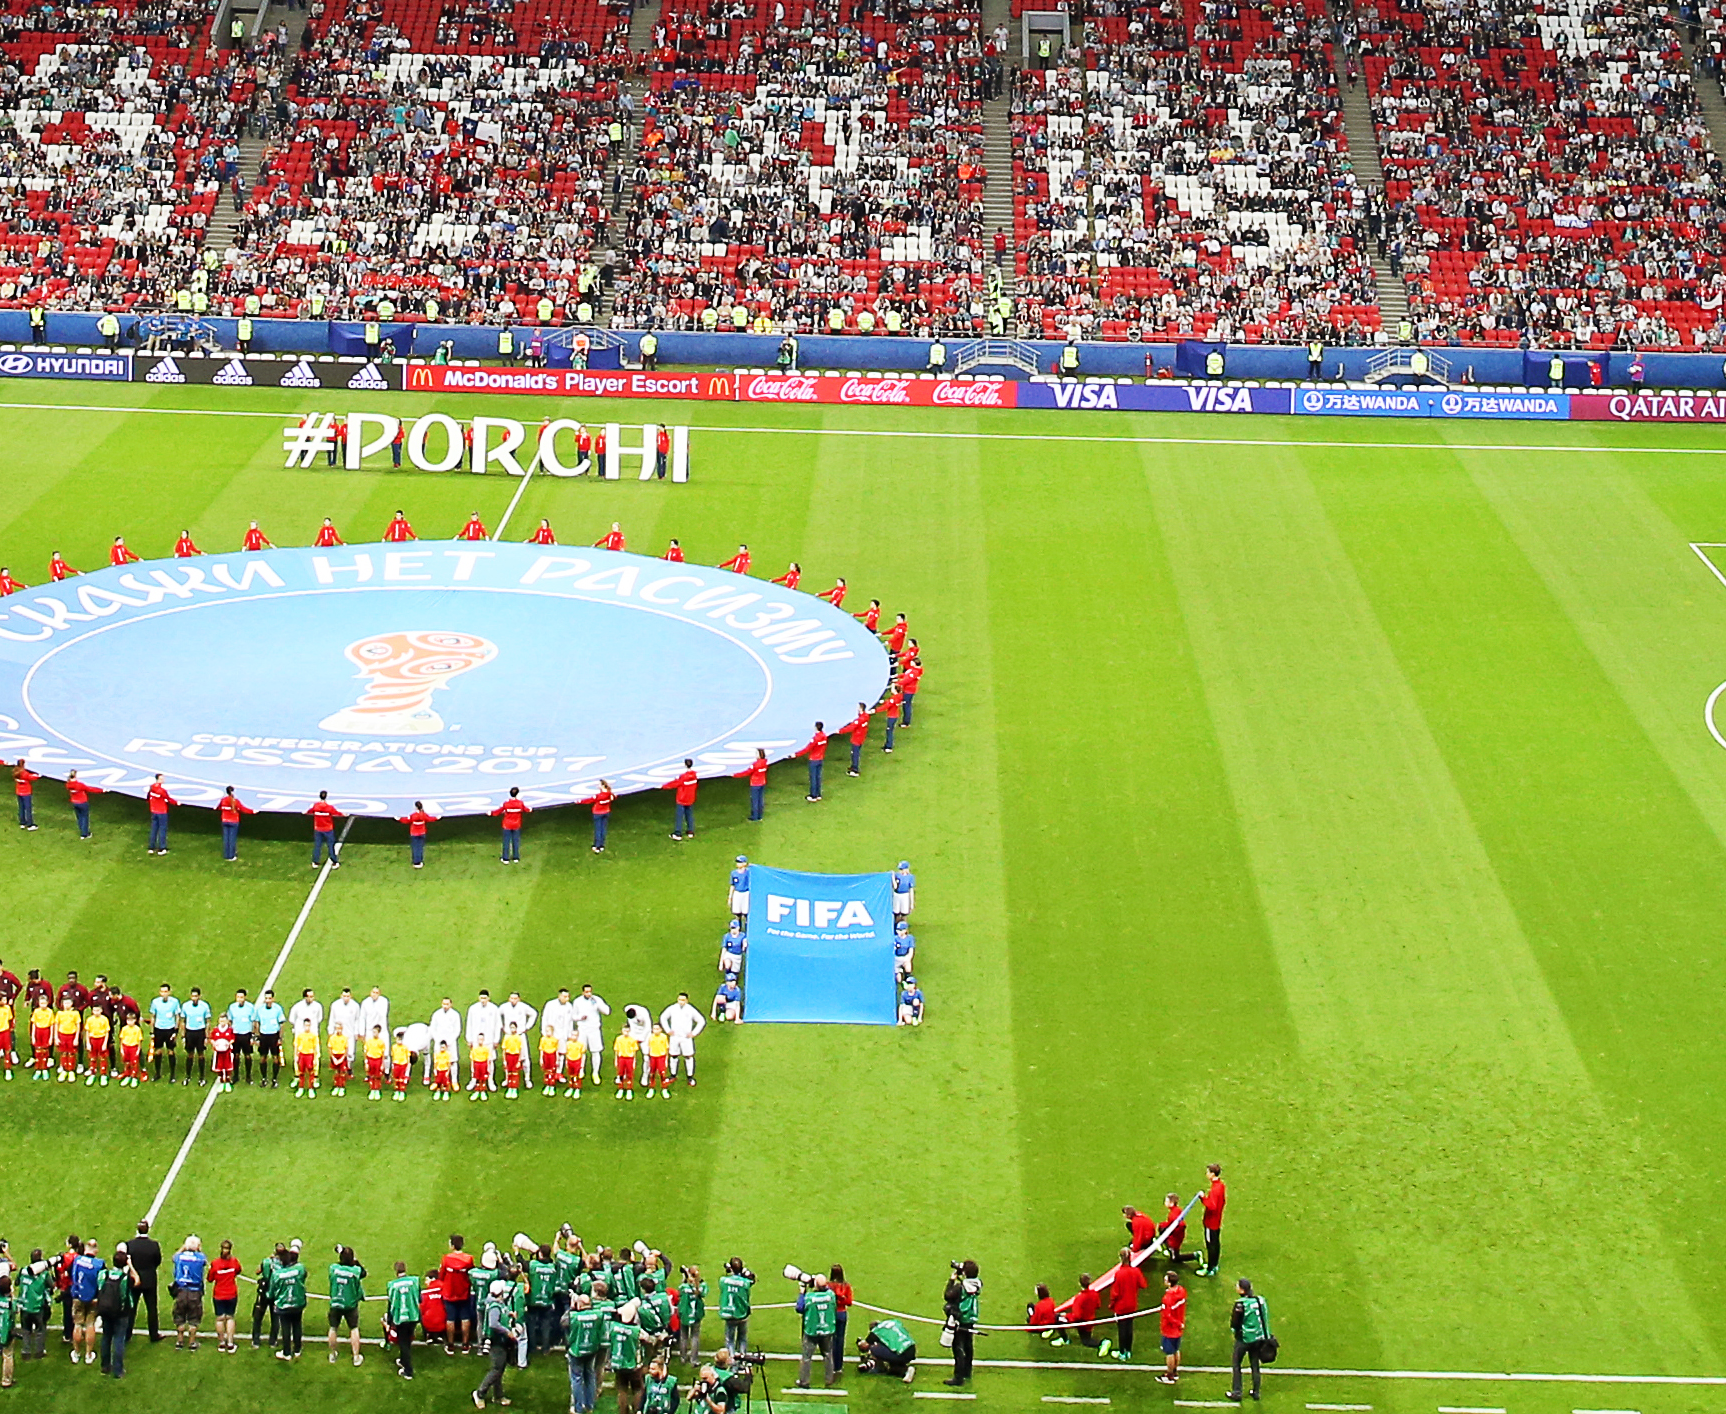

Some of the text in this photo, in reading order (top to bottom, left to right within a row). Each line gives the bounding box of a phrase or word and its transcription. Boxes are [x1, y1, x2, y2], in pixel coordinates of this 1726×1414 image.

[36, 356, 124, 375] HYUNDAI
[146, 373, 186, 384] adidas
[212, 375, 252, 386] adidas
[280, 377, 320, 388] adidas
[347, 379, 388, 390] adidas
[444, 370, 699, 394] McDonald's Player Escort
[748, 376, 817, 400] Coca-Cola
[840, 379, 909, 403] Coca-Cola
[932, 381, 1002, 406] Coca-Cola
[1047, 384, 1119, 410] VISA
[1183, 386, 1254, 413] VISA
[1609, 396, 1694, 420] QATAR
[283, 411, 690, 483] #PORCHI
[313, 550, 501, 587] НЕТ
[521, 556, 855, 668] РАСИЗМУ
[122, 737, 609, 774] RUSSIA 2017
[190, 732, 559, 758] CONFEDERATIONS CUP
[767, 893, 875, 929] FIFA
